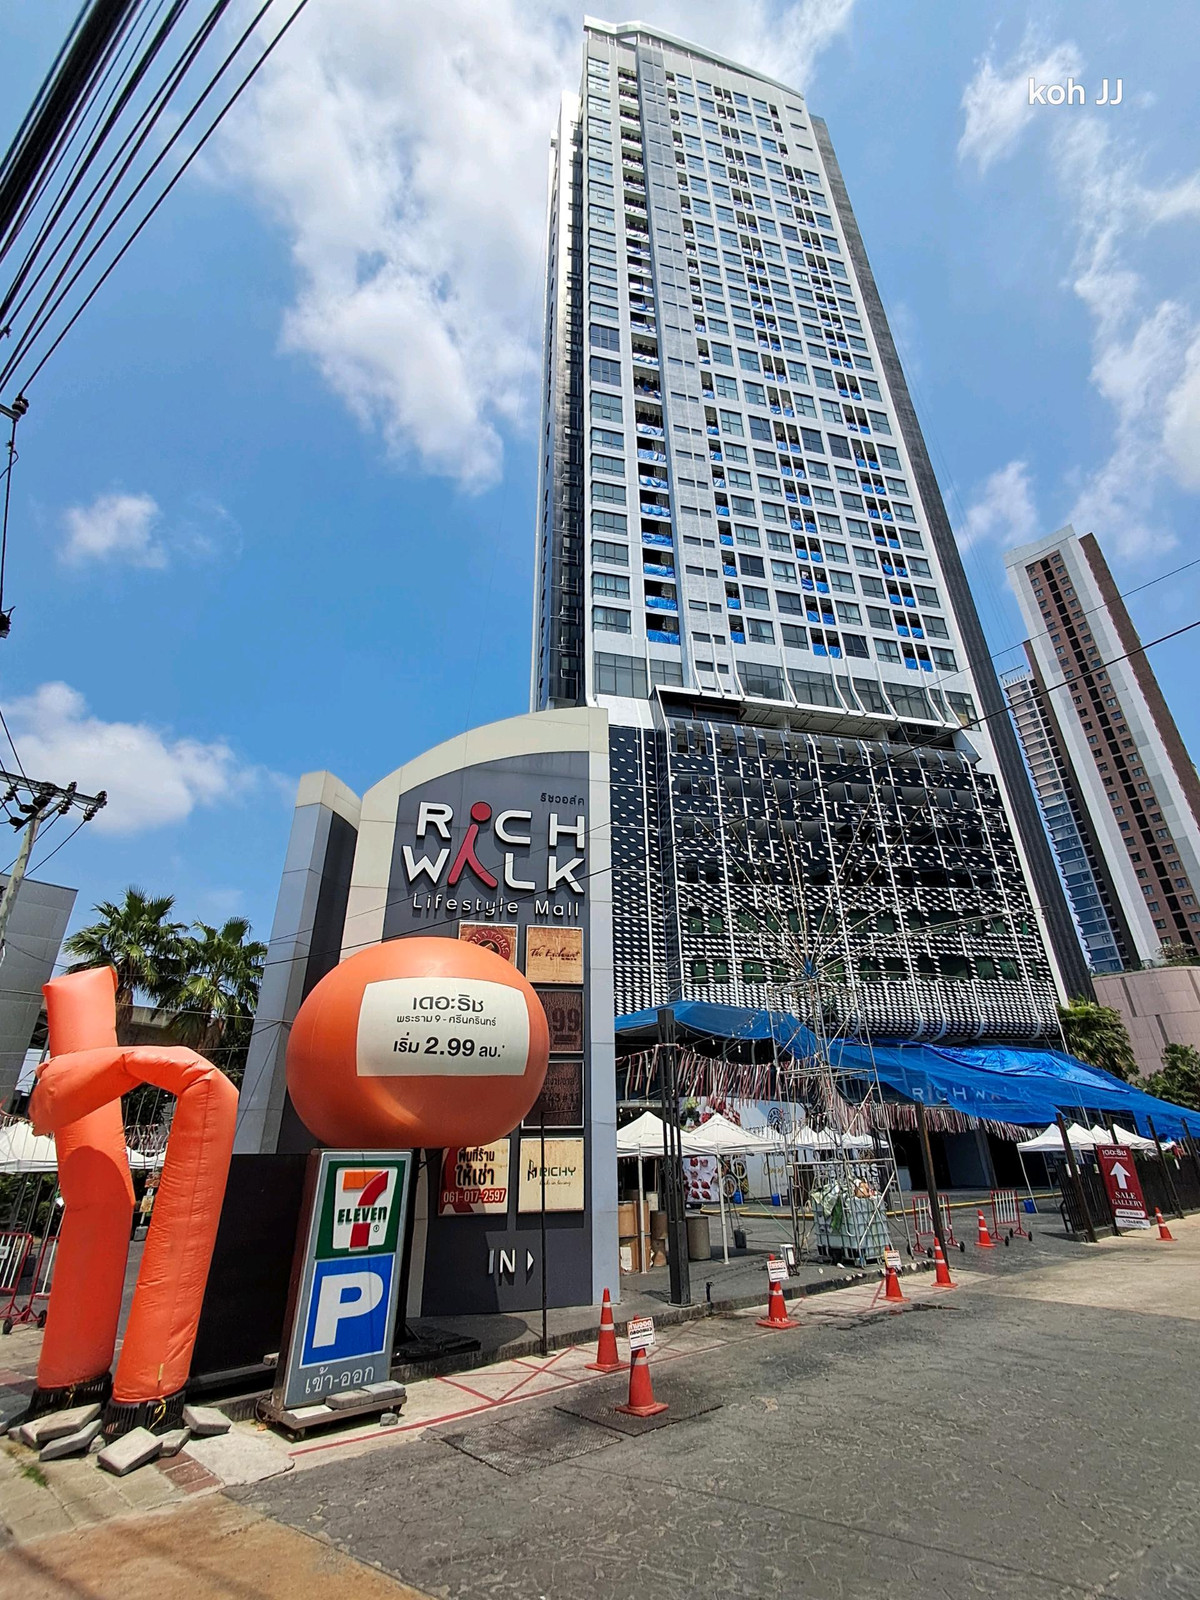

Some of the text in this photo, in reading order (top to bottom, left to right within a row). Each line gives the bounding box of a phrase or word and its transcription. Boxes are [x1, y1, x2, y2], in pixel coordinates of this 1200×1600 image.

[413, 892, 579, 917] Lifestyle Mall
[413, 993, 484, 1013] เดอะริช
[396, 1014, 433, 1023] พระราม
[434, 1014, 441, 1023] 9
[393, 1032, 420, 1054] เริ่ม
[423, 1036, 475, 1057] 2.99
[456, 1163, 495, 1186] ให้เช่า
[443, 1189, 507, 1204] 061-017-2597
[1114, 1191, 1137, 1200] SALE
[342, 1170, 389, 1248] 7
[488, 1249, 515, 1273] IN
[312, 1271, 384, 1349] P
[305, 1366, 374, 1394] เข้า-ออก
